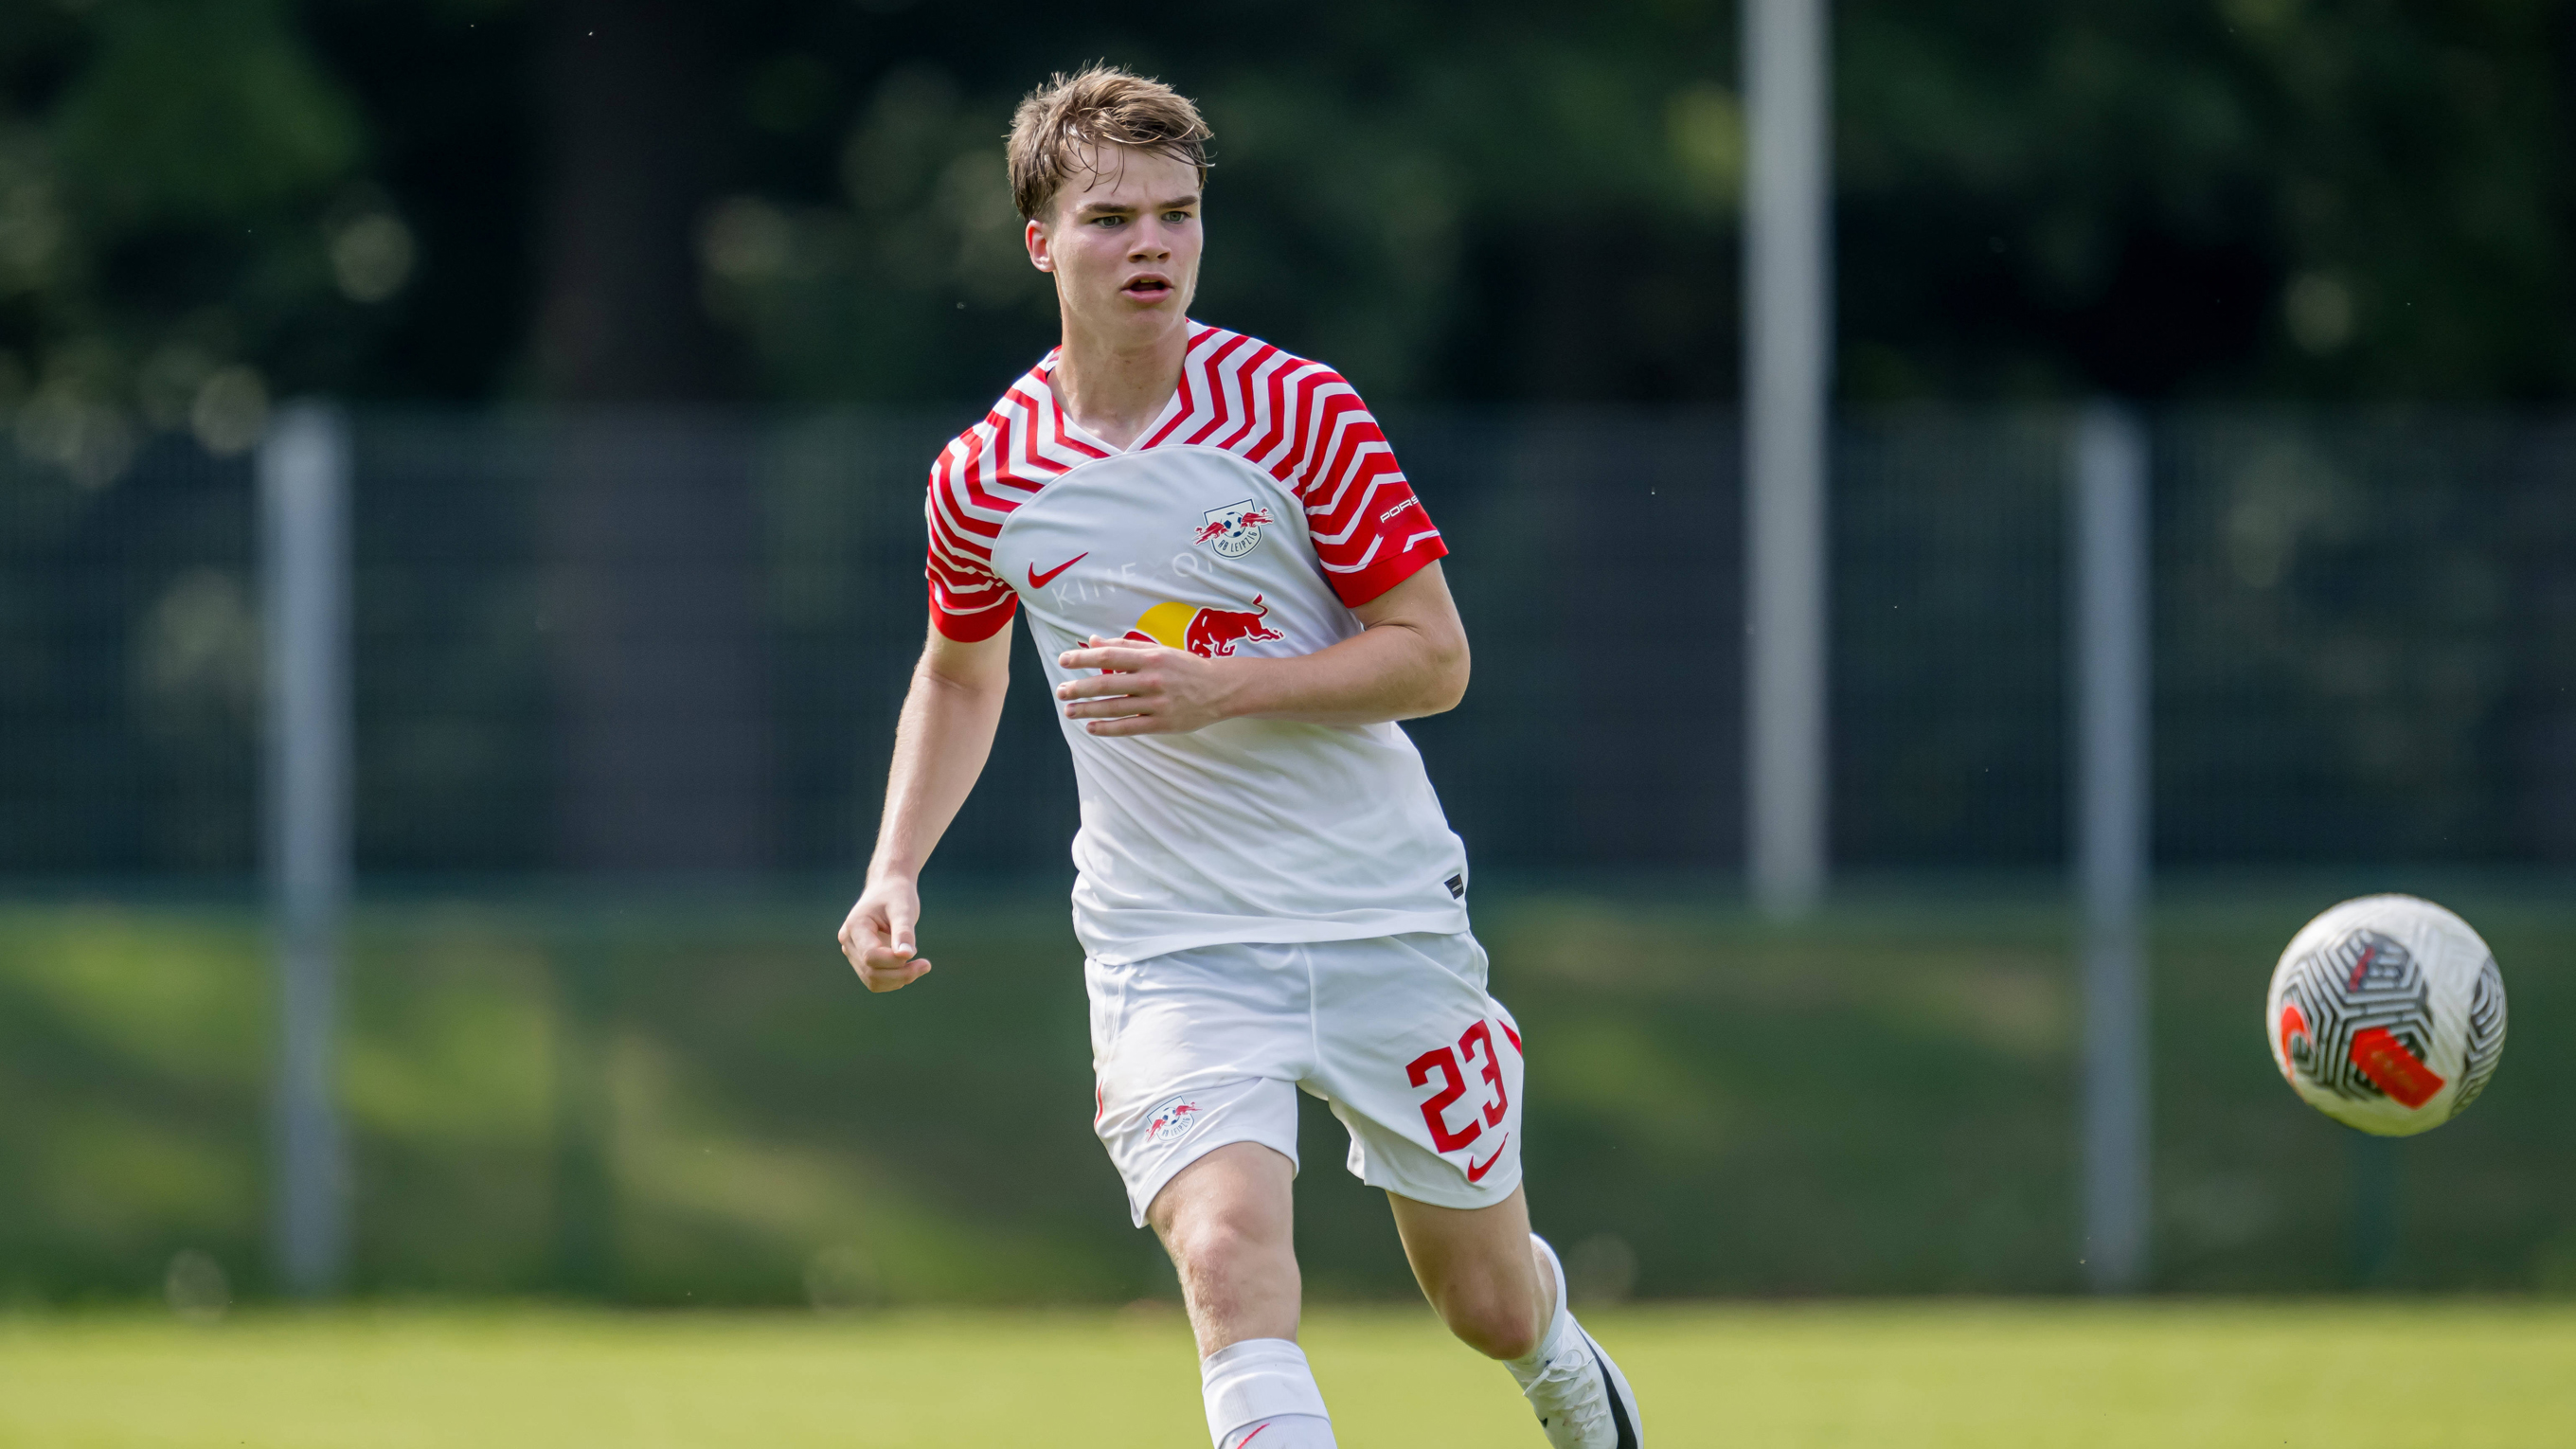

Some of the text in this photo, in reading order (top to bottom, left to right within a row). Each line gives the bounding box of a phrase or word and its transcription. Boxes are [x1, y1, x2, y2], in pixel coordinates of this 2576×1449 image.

[1379, 494, 1419, 524] PORS
[1230, 530, 1258, 552] LEIPZIG
[1405, 1019, 1508, 1154] 23
[1171, 1118, 1190, 1136] LEIPZIG
